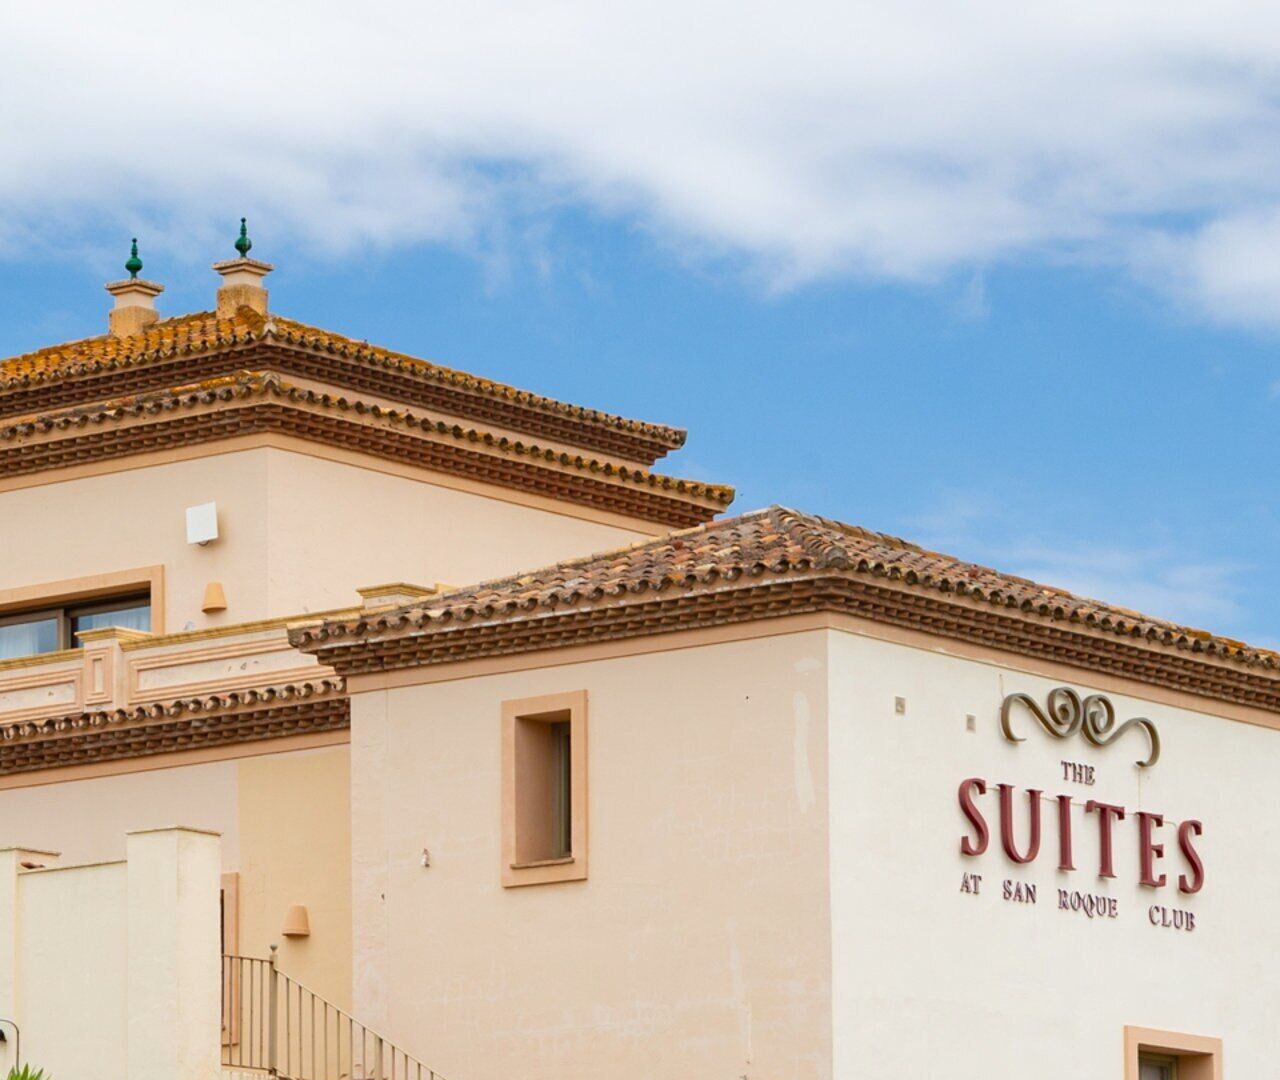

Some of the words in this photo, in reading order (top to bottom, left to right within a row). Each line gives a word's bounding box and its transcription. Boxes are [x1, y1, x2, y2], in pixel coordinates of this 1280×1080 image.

[1061, 760, 1096, 786] THE
[957, 777, 1205, 895] SUITES
[960, 872, 982, 895] AT
[1003, 880, 1037, 904] SAN
[1058, 888, 1118, 919] ROQUE
[1149, 905, 1196, 932] CLUB
